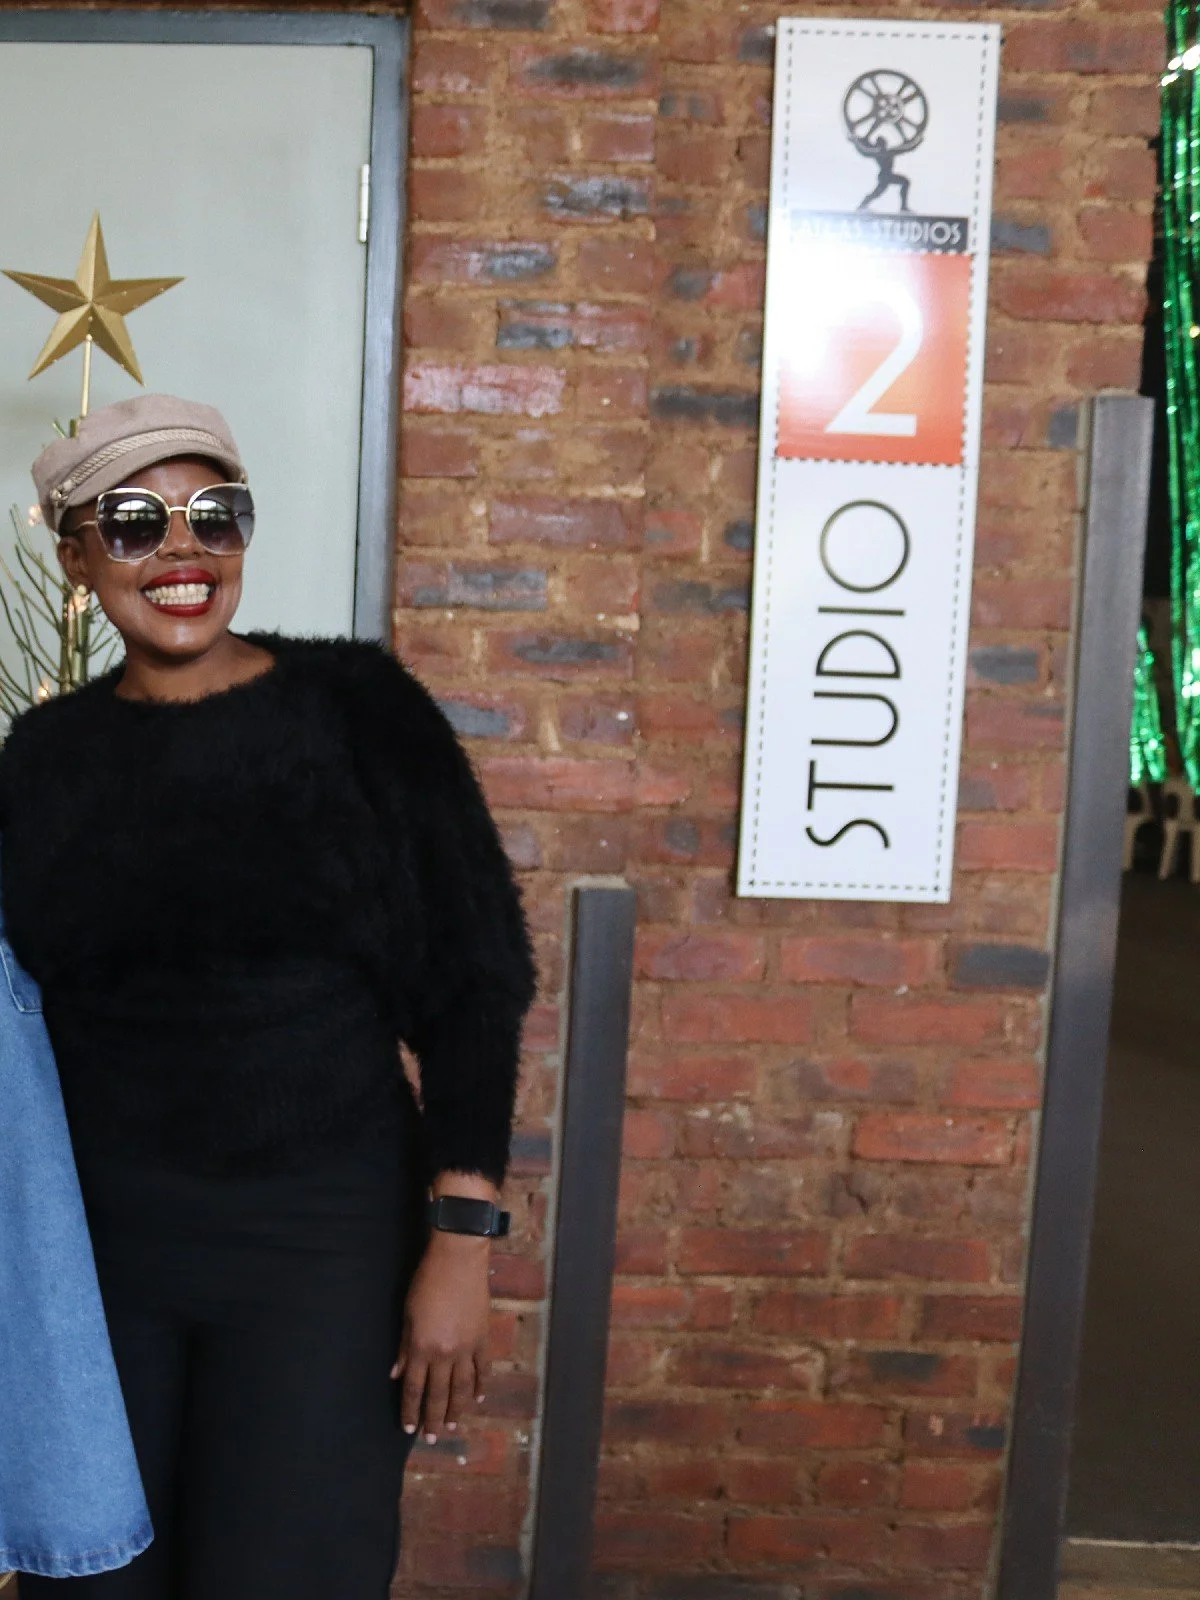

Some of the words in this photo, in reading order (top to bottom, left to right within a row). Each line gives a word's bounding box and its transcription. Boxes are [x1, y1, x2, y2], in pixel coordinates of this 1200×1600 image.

[871, 220, 962, 245] STUDIOS
[824, 285, 921, 437] 2
[804, 499, 911, 849] STUDIO
